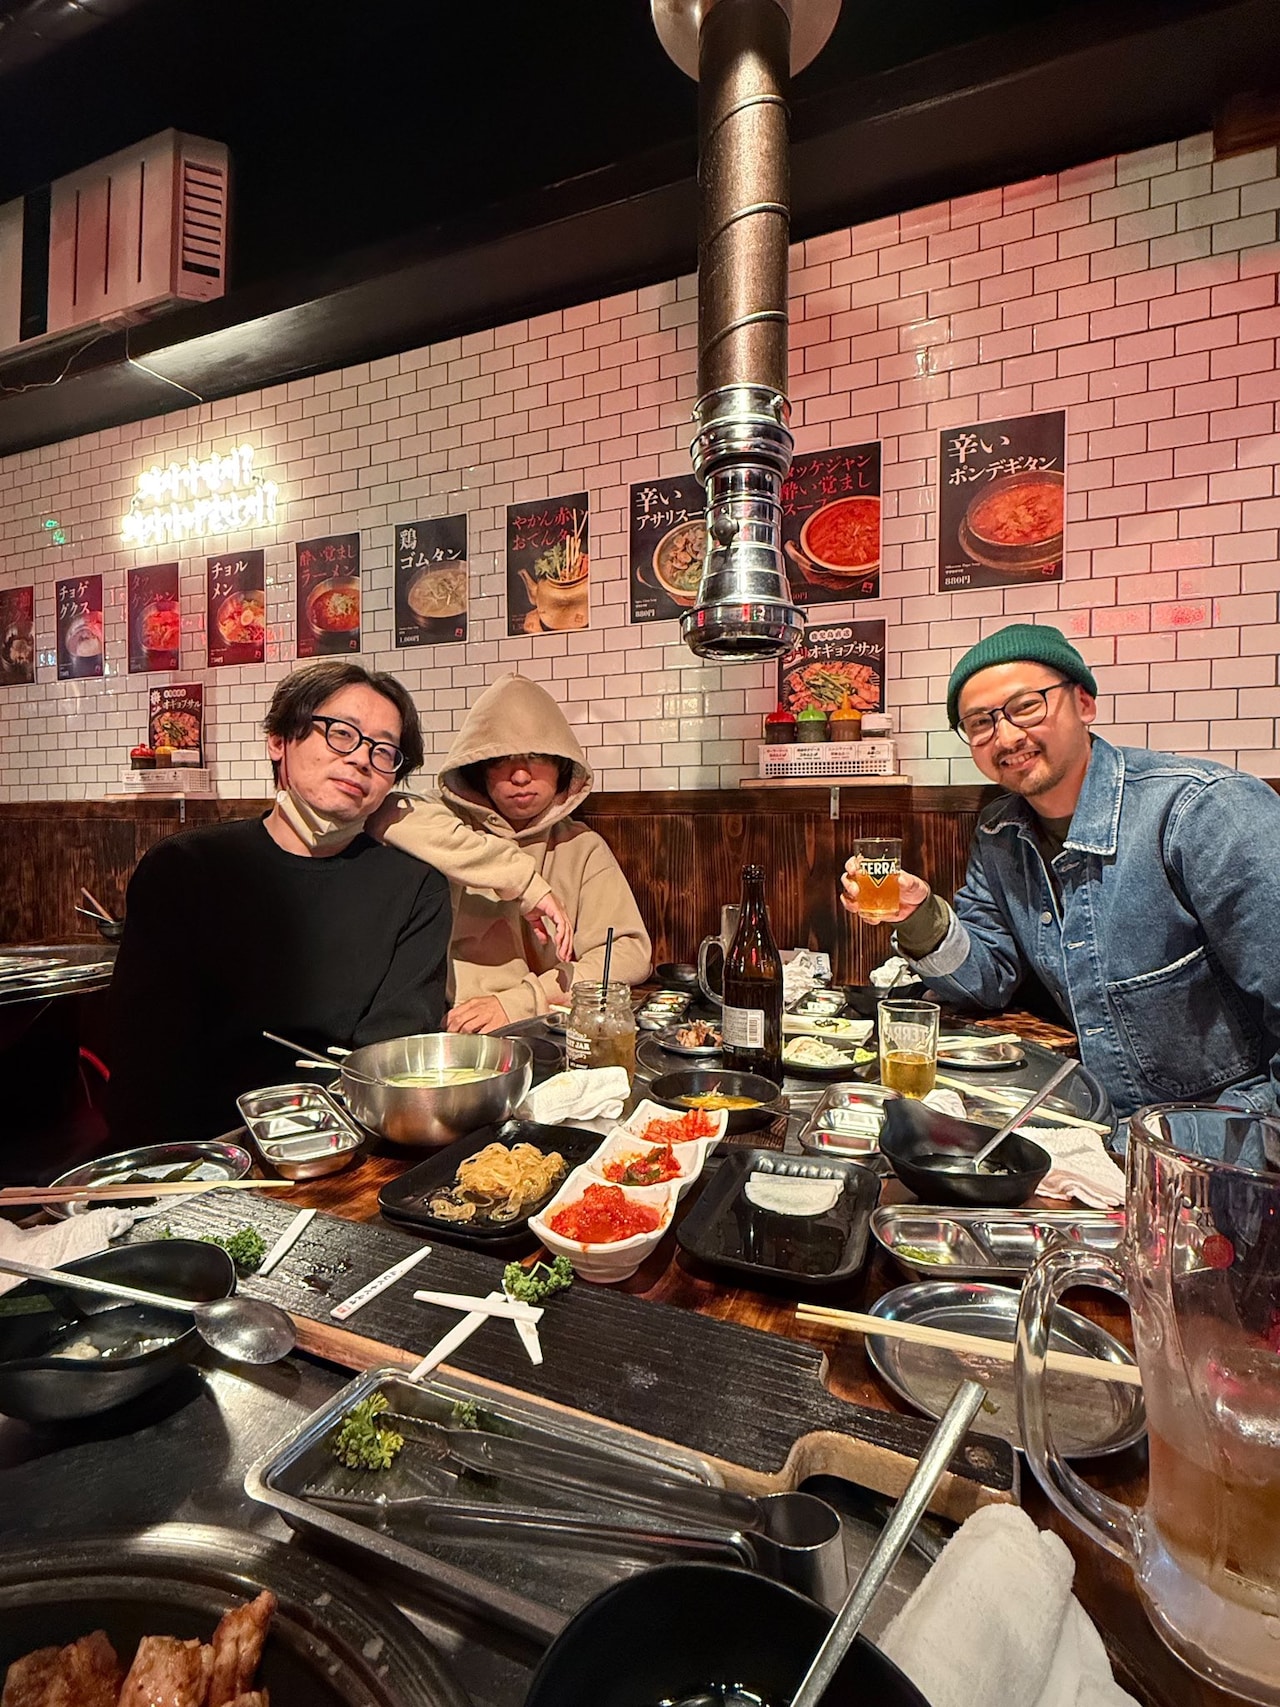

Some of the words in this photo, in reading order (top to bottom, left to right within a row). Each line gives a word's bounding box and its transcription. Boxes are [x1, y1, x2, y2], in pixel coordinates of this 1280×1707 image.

[947, 433, 1010, 464] 辛い
[948, 457, 1057, 486] ポンデギタン
[780, 472, 873, 500] 酔い覚まし
[635, 487, 682, 512] 辛い
[636, 507, 706, 531] アサリスー
[399, 528, 417, 551] 鶏
[300, 544, 357, 566] 酔い覚まし
[400, 547, 461, 569] ゴムタン
[212, 560, 248, 580] チョル
[301, 563, 355, 587] ラーメン
[945, 575, 971, 585] 880円
[59, 580, 89, 602] チョゲ
[212, 582, 233, 600] メン
[60, 601, 90, 620] グクス
[809, 640, 884, 659] オギョプサル
[861, 861, 896, 875] TERRA
